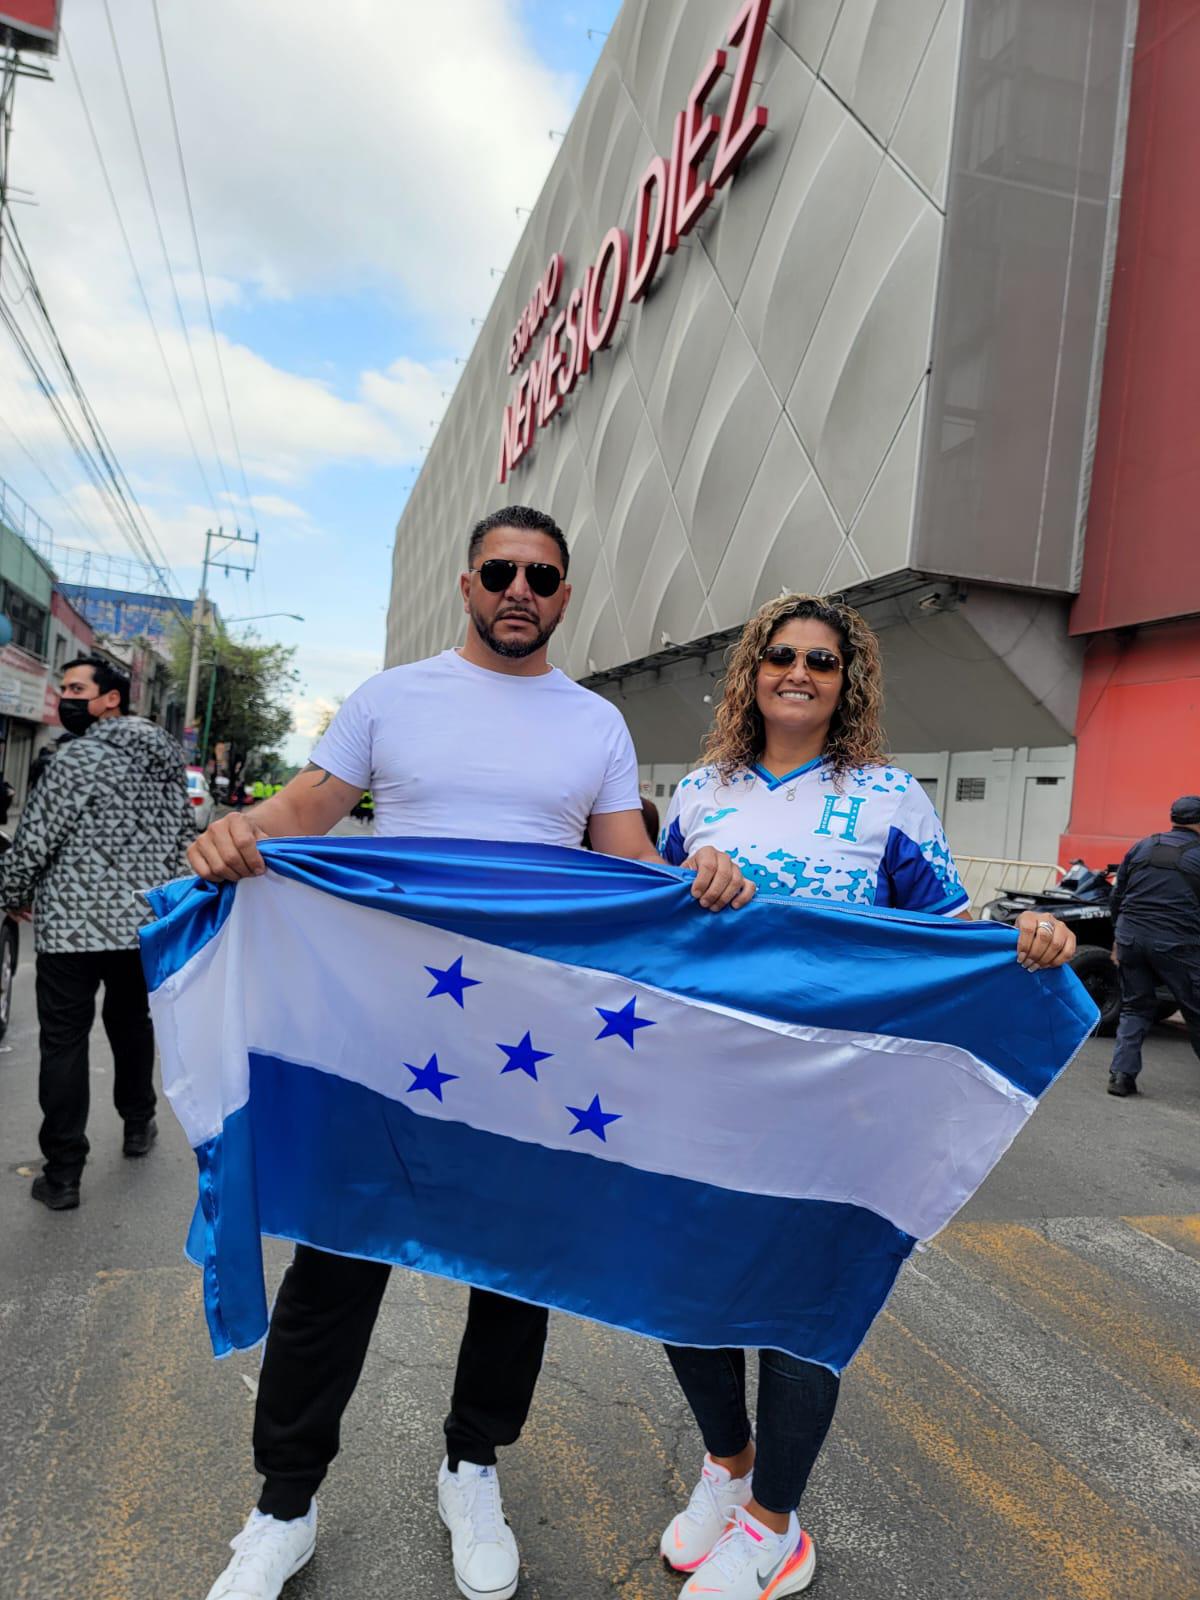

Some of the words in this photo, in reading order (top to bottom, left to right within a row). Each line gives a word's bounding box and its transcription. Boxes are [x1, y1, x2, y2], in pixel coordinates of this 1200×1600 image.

[497, 227, 628, 483] NEMESIO
[629, 0, 769, 303] DIEZ
[814, 794, 866, 843] H
